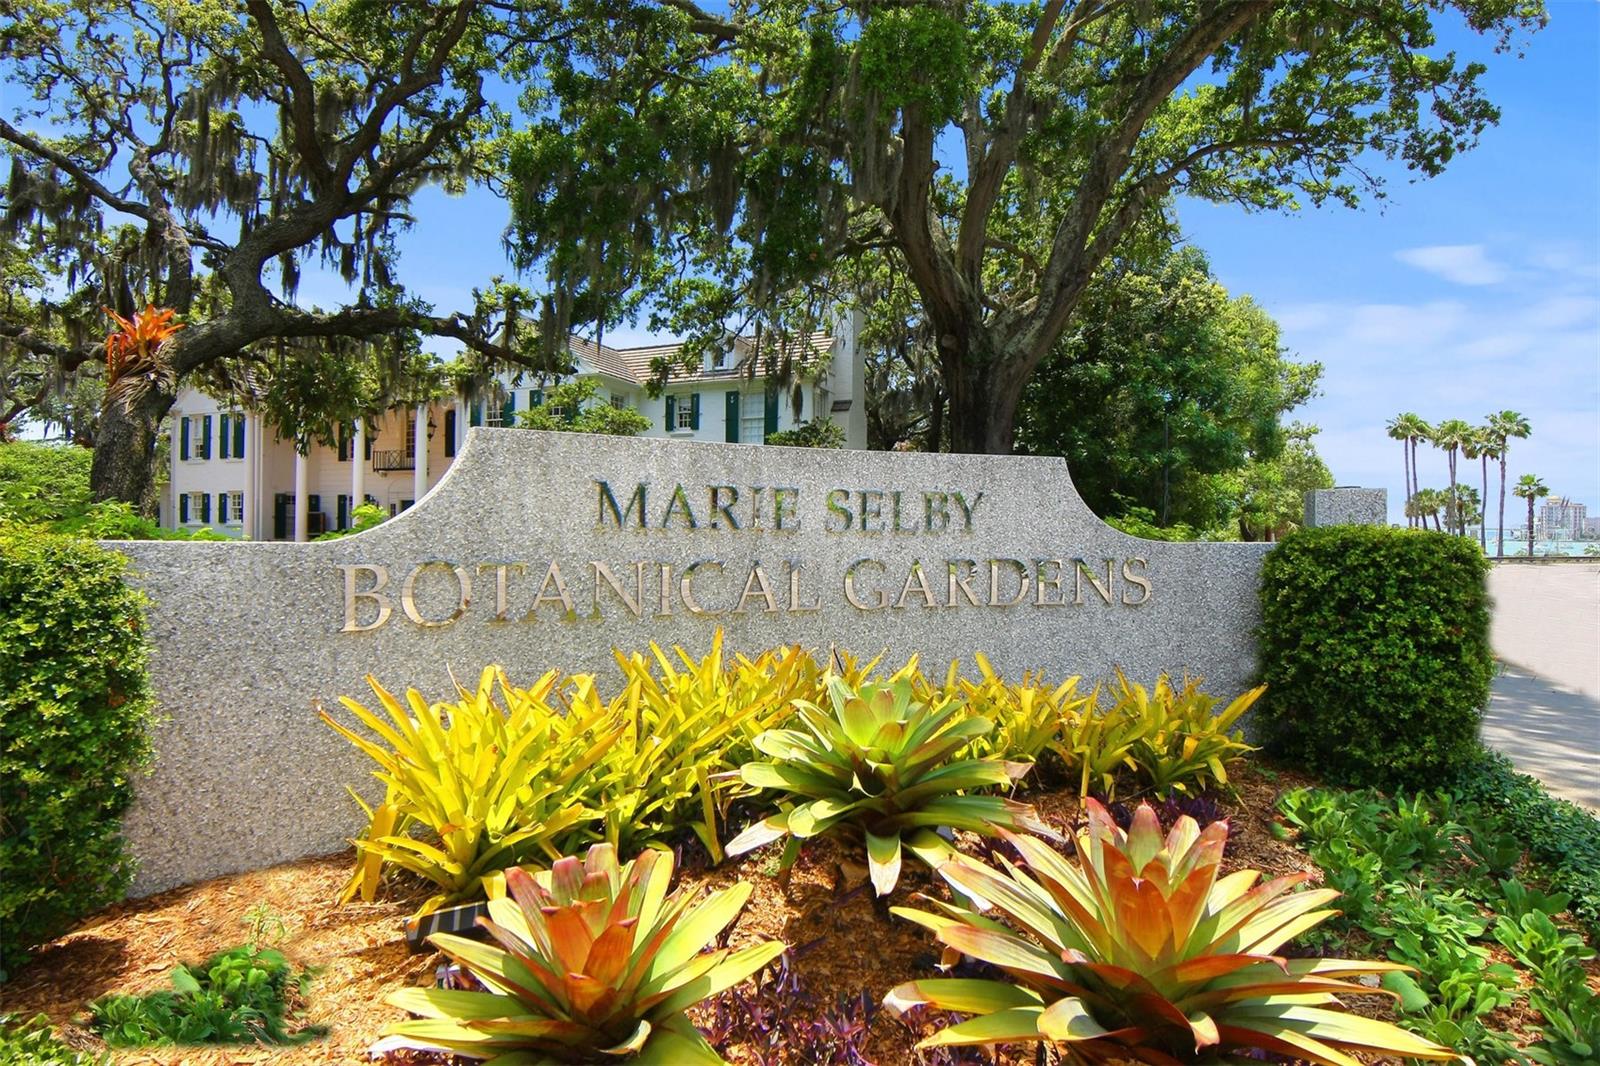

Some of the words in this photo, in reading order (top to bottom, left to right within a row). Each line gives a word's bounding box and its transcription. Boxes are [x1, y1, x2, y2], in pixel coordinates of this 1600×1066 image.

[594, 479, 800, 532] MARIE
[825, 487, 984, 534] SELBY
[337, 557, 821, 633] BOTANICAL
[843, 556, 1153, 611] GARDENS
